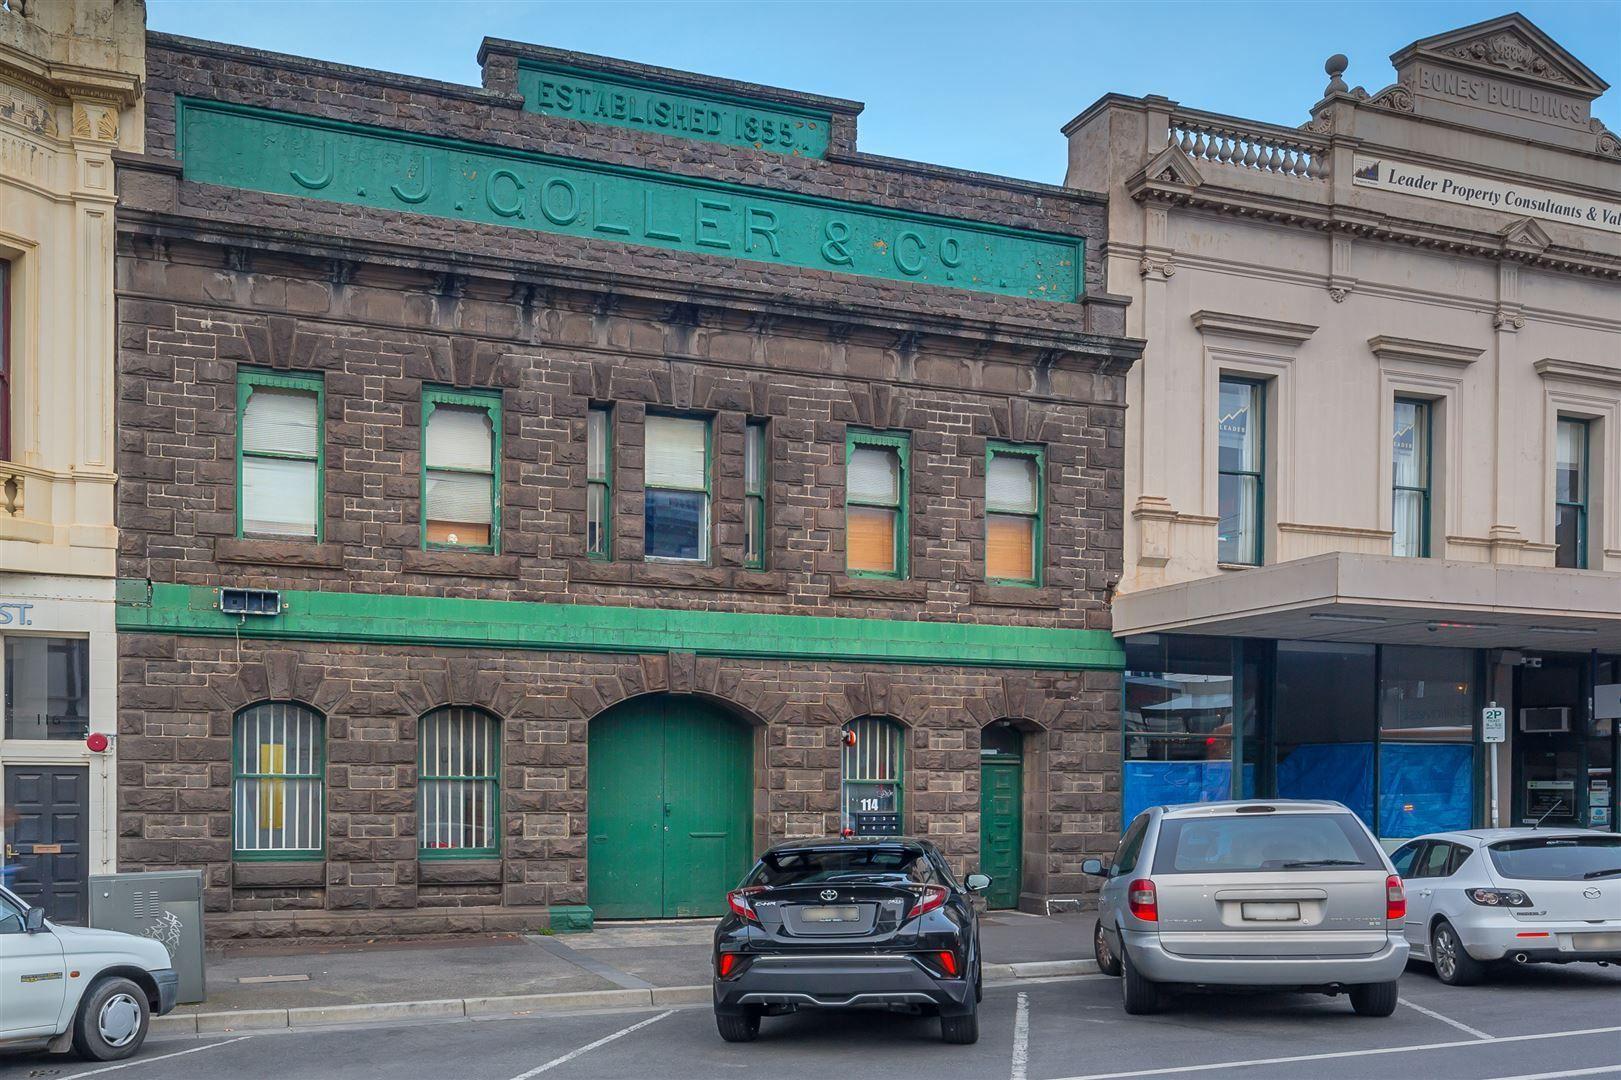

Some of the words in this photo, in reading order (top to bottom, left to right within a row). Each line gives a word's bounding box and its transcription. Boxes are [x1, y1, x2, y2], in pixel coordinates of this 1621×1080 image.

[538, 80, 722, 136] ESTABLISHED
[1388, 168, 1438, 191] Leader
[1441, 178, 1501, 206] Property
[1504, 190, 1582, 219] Consultants
[1586, 206, 1598, 222] &
[485, 168, 781, 258] COLLER
[820, 219, 855, 268] &
[1393, 441, 1412, 449] EADER
[0, 602, 33, 626] ST.
[37, 713, 61, 726] 116
[1486, 710, 1502, 720] 2P
[860, 798, 879, 811] 114
